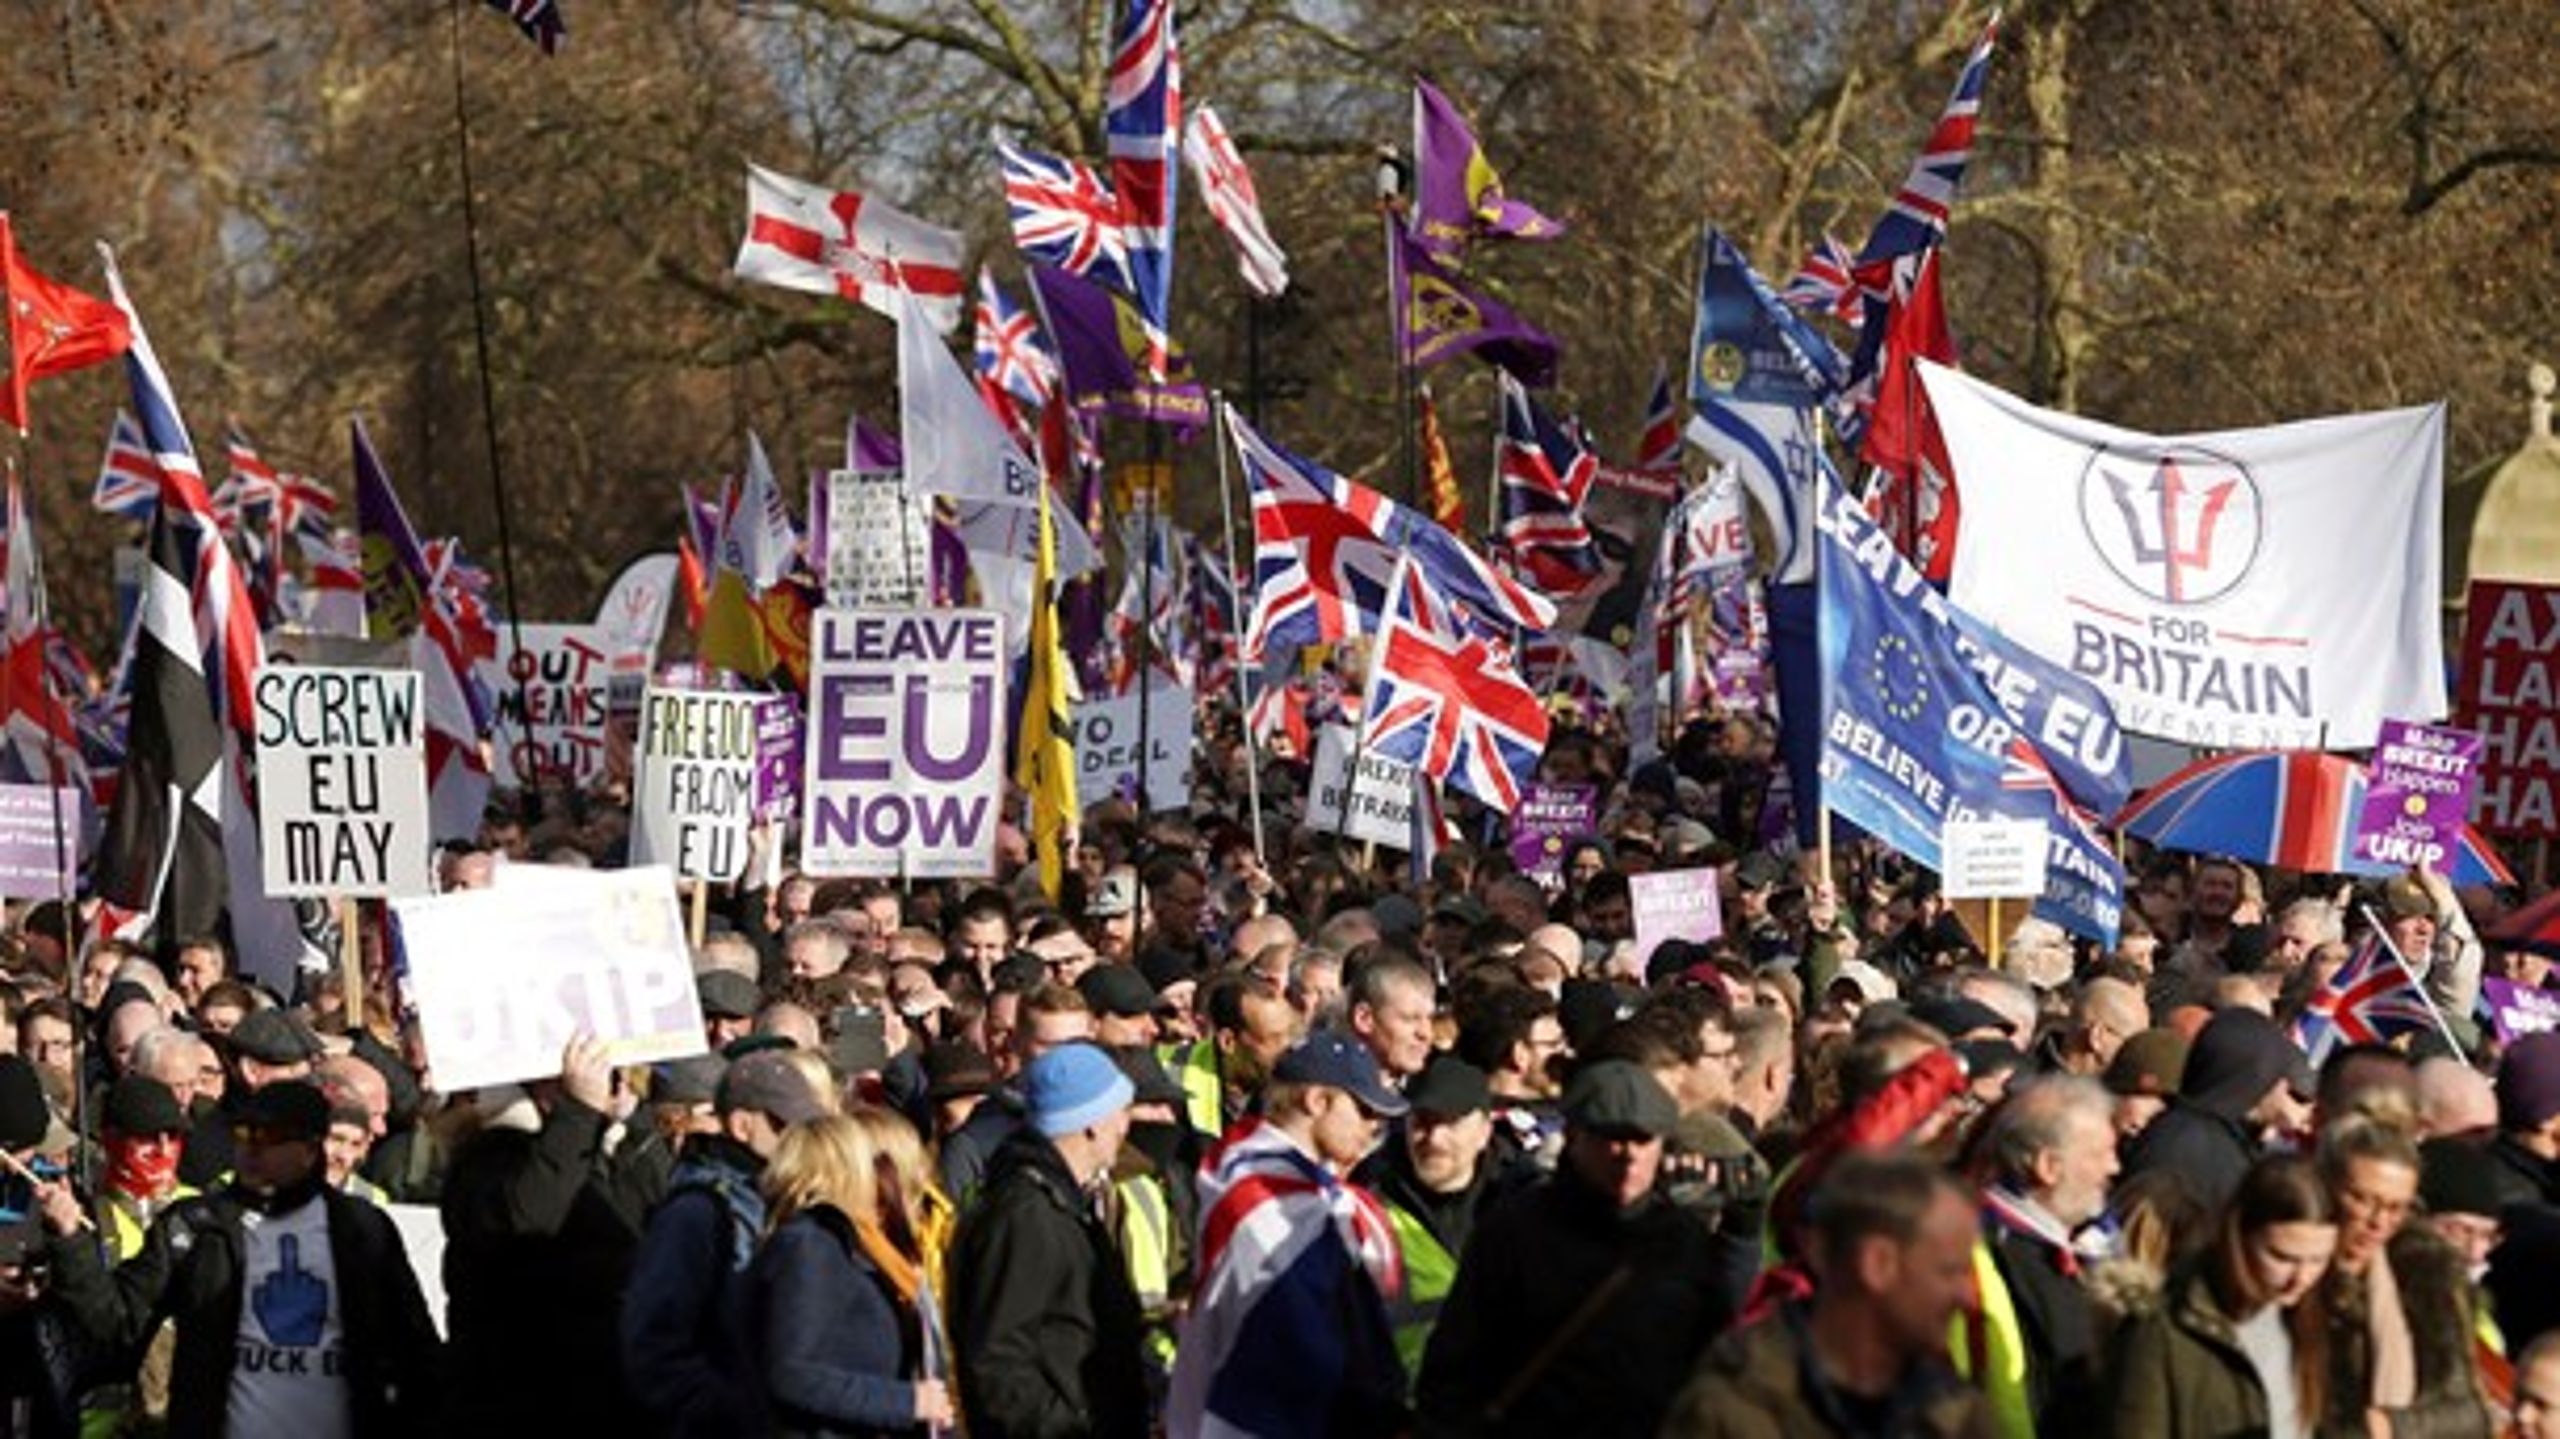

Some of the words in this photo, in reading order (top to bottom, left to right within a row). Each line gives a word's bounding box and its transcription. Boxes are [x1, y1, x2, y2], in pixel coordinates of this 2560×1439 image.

[822, 618, 995, 662] LEAVE
[2149, 615, 2210, 646] FOR
[507, 636, 605, 684] OUT
[2072, 621, 2312, 718] BRITAIN
[256, 674, 416, 748] SCREW
[496, 684, 606, 727] MEANS
[818, 674, 995, 781] EU
[1949, 703, 2012, 754] OR
[512, 730, 604, 786] OUT
[1829, 711, 1945, 812] BELIEVE
[2042, 694, 2120, 775] EU
[2383, 745, 2469, 776] BREXIT
[2403, 728, 2456, 751] Make
[308, 754, 380, 815] EU
[670, 763, 752, 818] FROM
[813, 794, 990, 848] NOW
[286, 821, 392, 885] MAY
[678, 823, 735, 878] EU
[2369, 833, 2444, 865] UKIP
